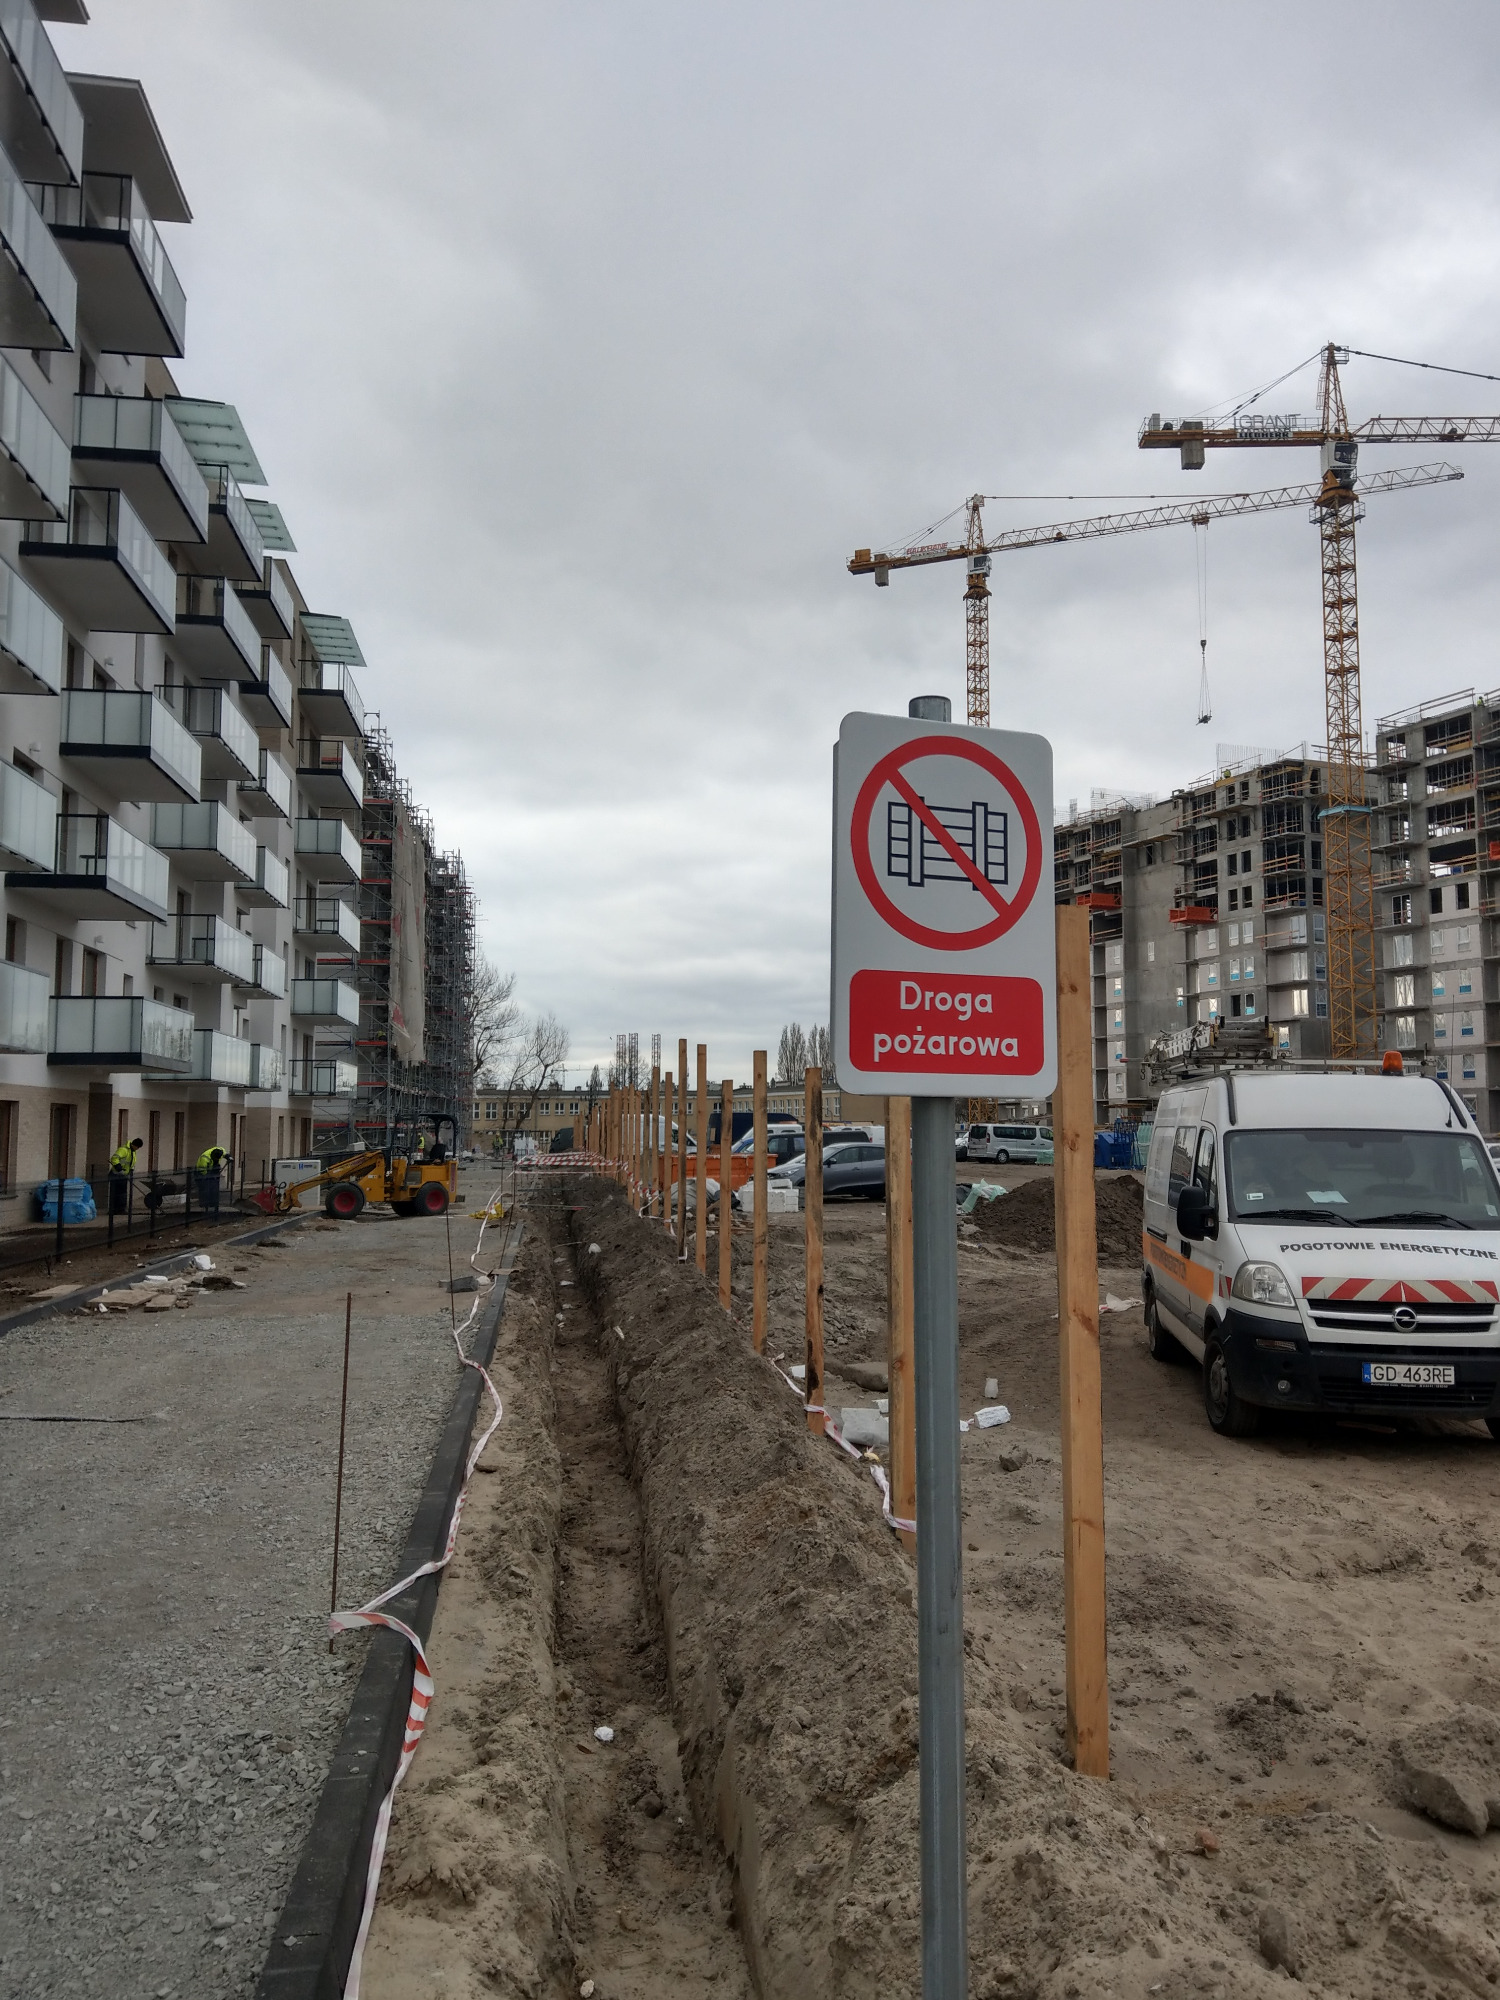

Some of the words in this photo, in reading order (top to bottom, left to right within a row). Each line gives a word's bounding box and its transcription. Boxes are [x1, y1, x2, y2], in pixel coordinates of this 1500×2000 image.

[900, 980, 993, 1021] Droga
[873, 1025, 1019, 1063] pożarowa
[1280, 1242, 1375, 1253] POGOTOWIE
[1380, 1242, 1498, 1260] ENERGETYCZNE
[1373, 1366, 1397, 1381] GD
[1403, 1367, 1452, 1383] 463RE
